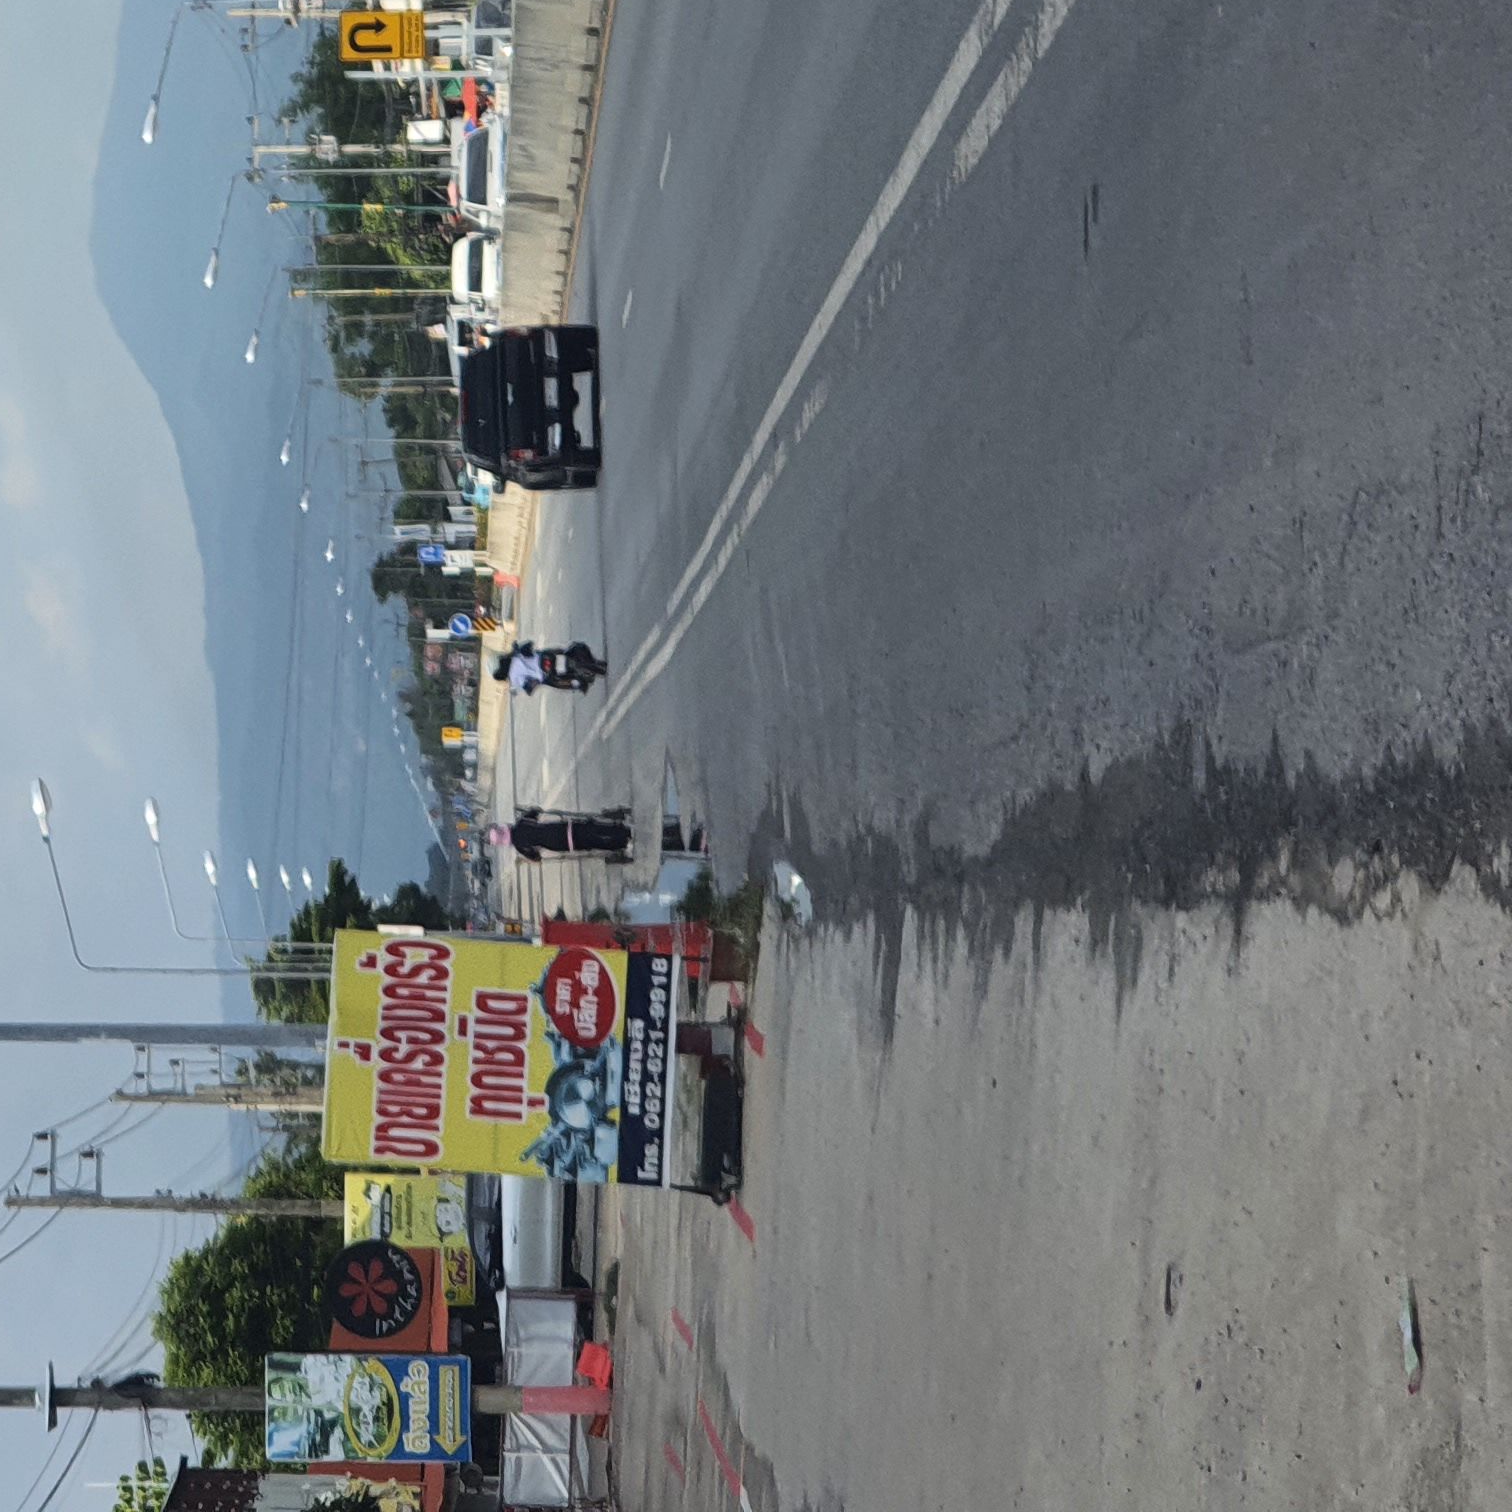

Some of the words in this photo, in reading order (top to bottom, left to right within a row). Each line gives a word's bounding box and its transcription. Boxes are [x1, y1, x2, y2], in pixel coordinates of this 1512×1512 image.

[336, 939, 452, 1158] ขายเครื่องครัว
[457, 990, 545, 1121] ทุกชนิด
[637, 1137, 660, 1180] โทร.
